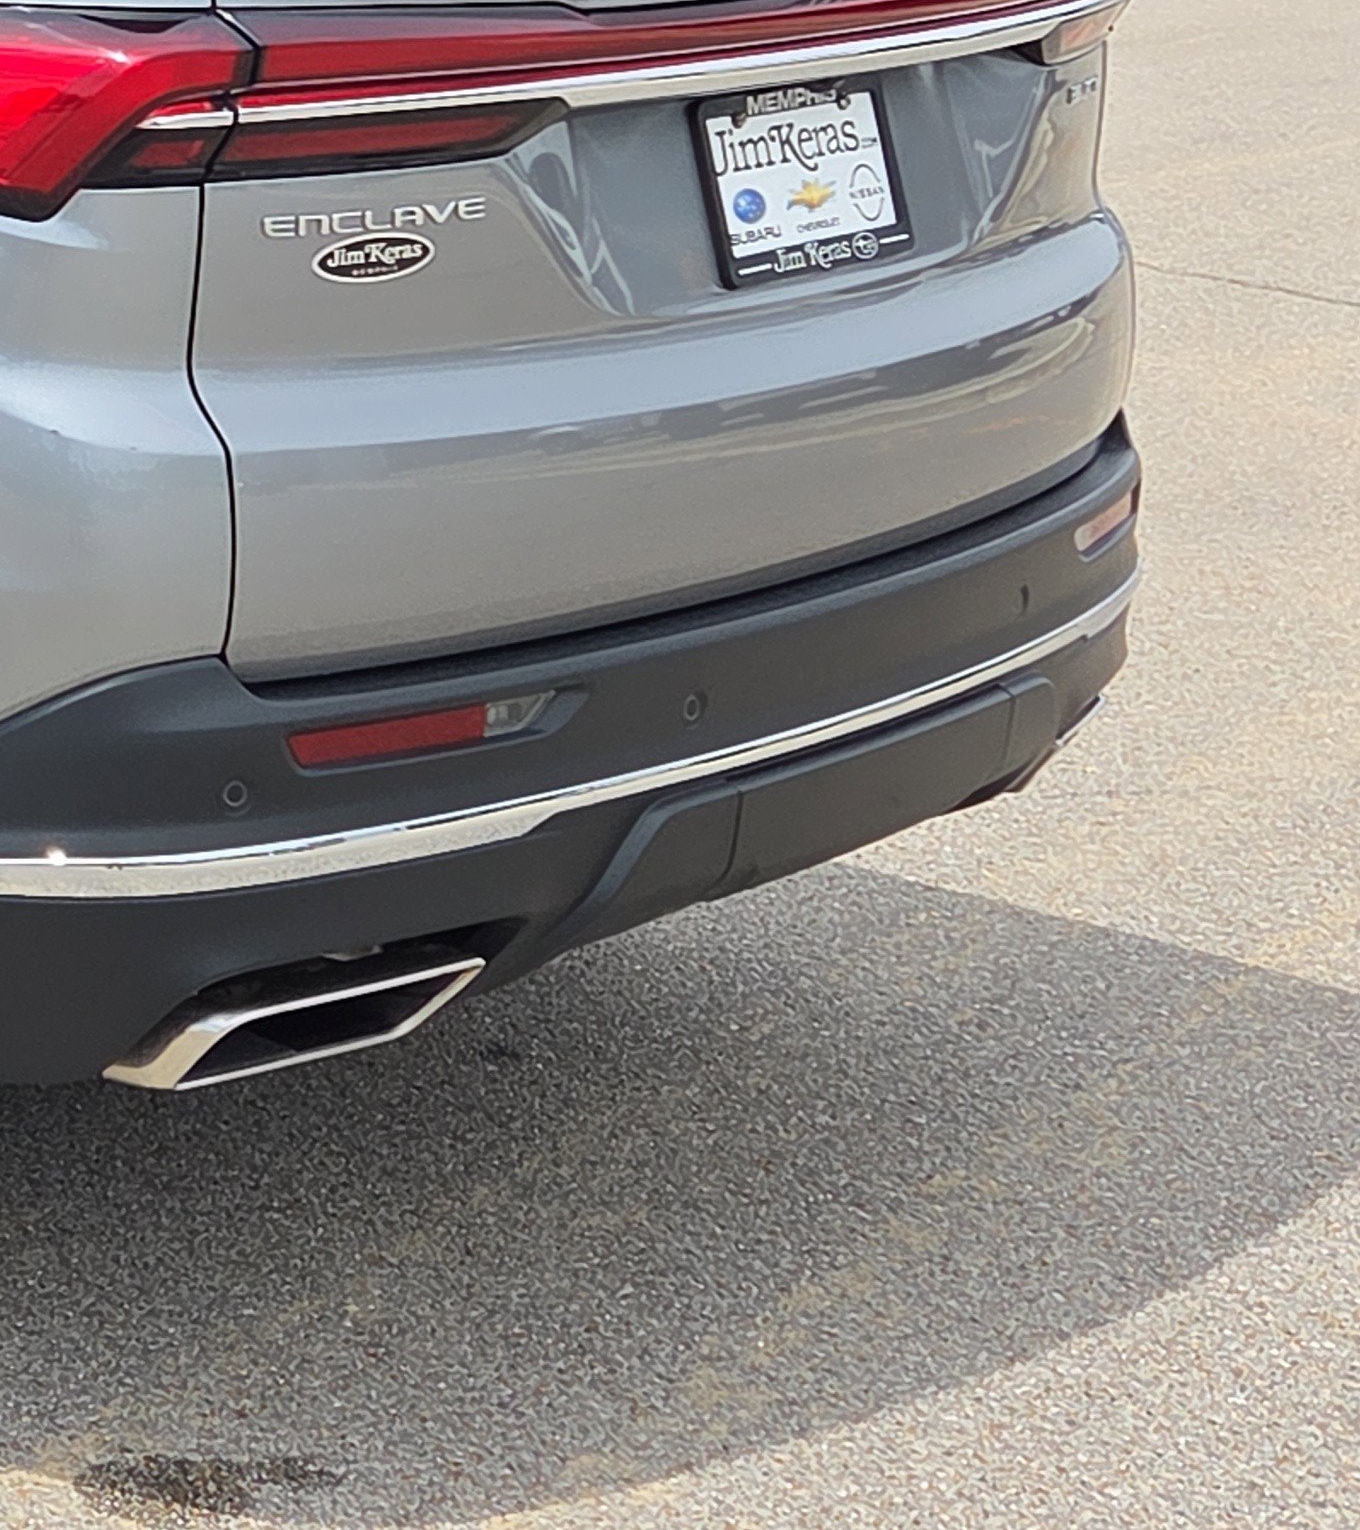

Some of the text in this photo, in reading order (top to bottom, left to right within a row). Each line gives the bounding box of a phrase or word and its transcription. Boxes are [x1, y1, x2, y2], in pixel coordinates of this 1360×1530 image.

[746, 88, 837, 116] MEMPHIS
[262, 196, 486, 238] ENCLAVE
[730, 225, 781, 246] SUBARU
[804, 239, 851, 270] Keras
